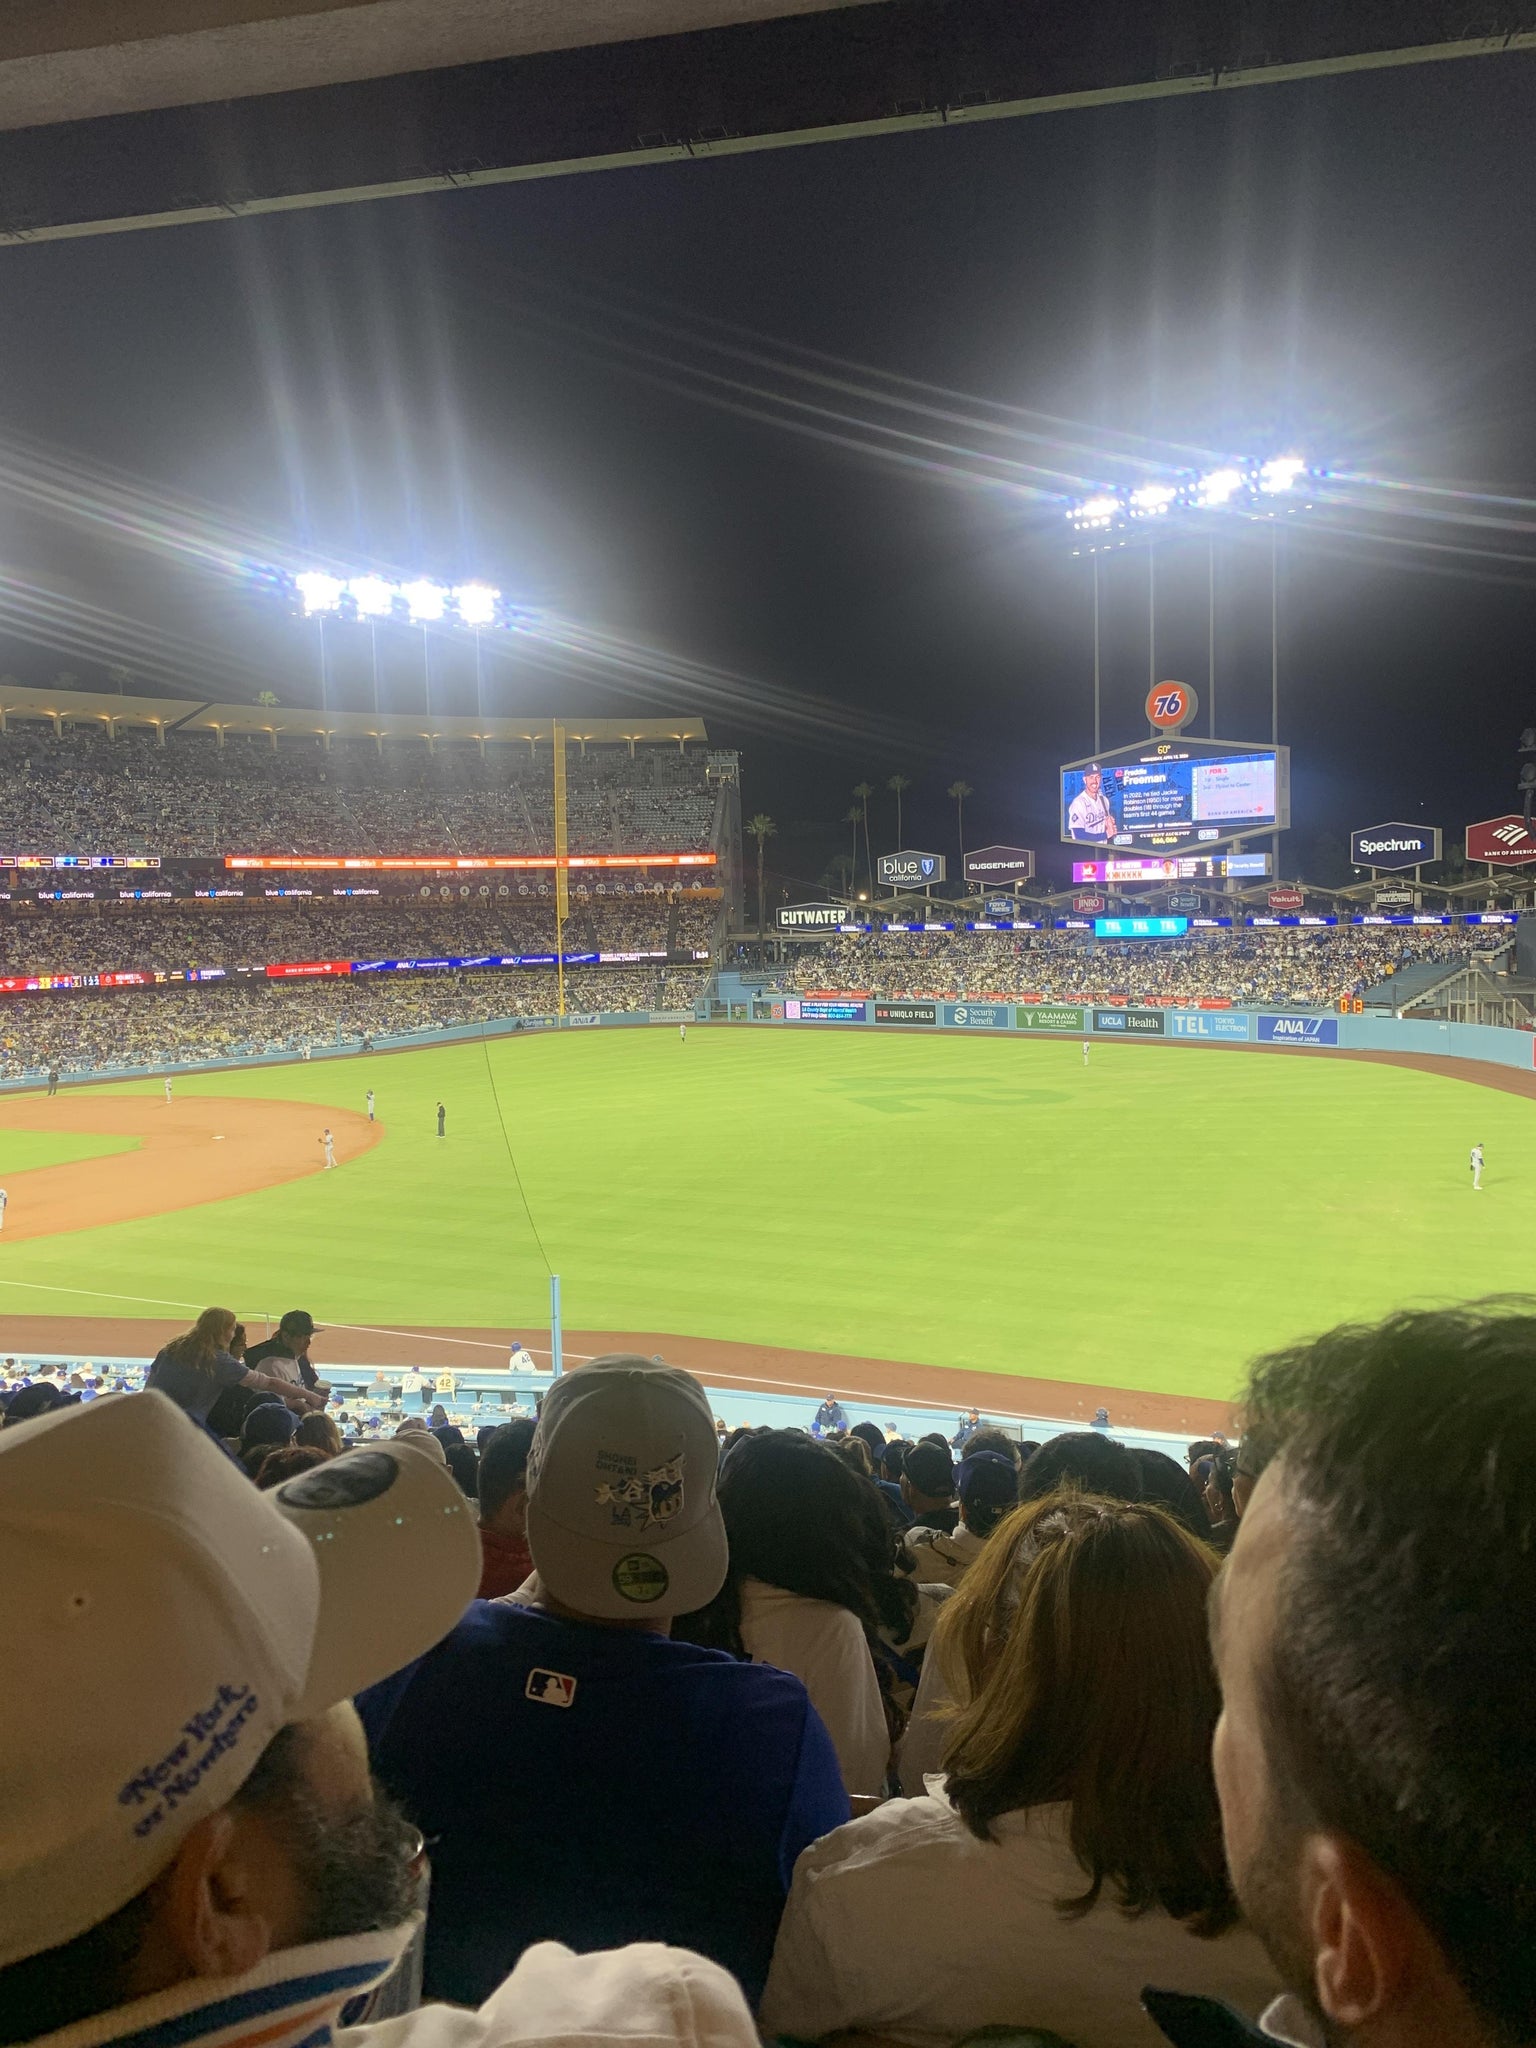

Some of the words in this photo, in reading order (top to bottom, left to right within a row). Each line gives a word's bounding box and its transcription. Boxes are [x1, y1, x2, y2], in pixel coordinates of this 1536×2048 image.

[1154, 691, 1181, 717] 76
[1124, 768, 1147, 776] Freddie
[1123, 774, 1166, 786] Freeman
[1360, 838, 1421, 855] Spectrum
[883, 859, 918, 875] blue
[969, 861, 1025, 870] GUGGENHEIM
[62, 891, 94, 899] california
[141, 890, 172, 898] california
[195, 890, 209, 898] blue
[215, 889, 244, 897] california
[284, 888, 312, 896] california
[352, 888, 379, 896] california
[1078, 898, 1100, 910] JINRO
[1270, 895, 1302, 903] Yakult
[780, 910, 846, 925] CUTWATER
[1105, 920, 1122, 930] TEL
[1132, 920, 1149, 930] TEL
[1160, 919, 1177, 930] TEL
[773, 1007, 781, 1015] 76
[1340, 999, 1362, 1014] 0:13
[889, 1010, 914, 1018] UNIQLO
[914, 1010, 934, 1019] FIELD
[969, 1008, 997, 1017] Security
[970, 1017, 994, 1025] Benefit
[1101, 1017, 1122, 1026] UCLA
[1127, 1016, 1158, 1028] Health
[1174, 1015, 1208, 1034] TEL
[1215, 1024, 1246, 1032] ELECTRON
[1273, 1019, 1304, 1034] ANA
[522, 1353, 530, 1364] 42
[405, 1379, 414, 1389] 17
[439, 1378, 451, 1387] 42
[597, 1449, 637, 1465] SHOHEI
[596, 1460, 637, 1475] OHTANI
[117, 1739, 189, 1805] New
[182, 1683, 250, 1742] York
[160, 1693, 258, 1811] Nowhere
